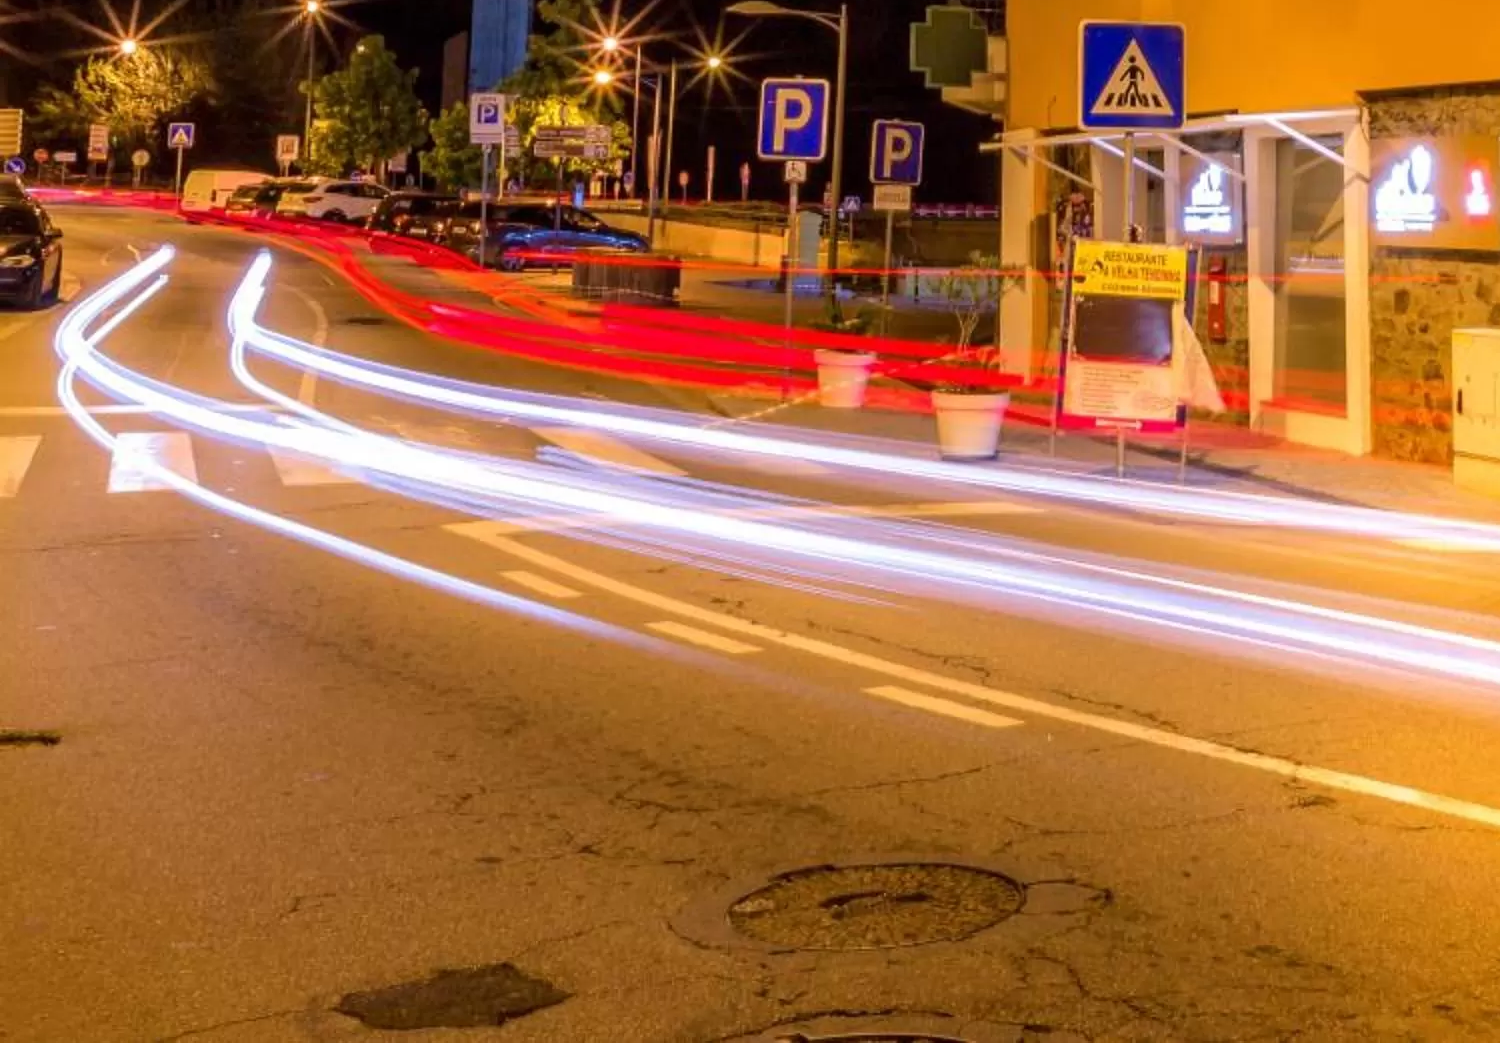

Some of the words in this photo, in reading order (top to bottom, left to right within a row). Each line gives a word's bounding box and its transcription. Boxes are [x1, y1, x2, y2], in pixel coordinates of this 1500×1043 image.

[481, 105, 495, 124] P
[773, 88, 813, 153] P
[883, 128, 912, 178] P
